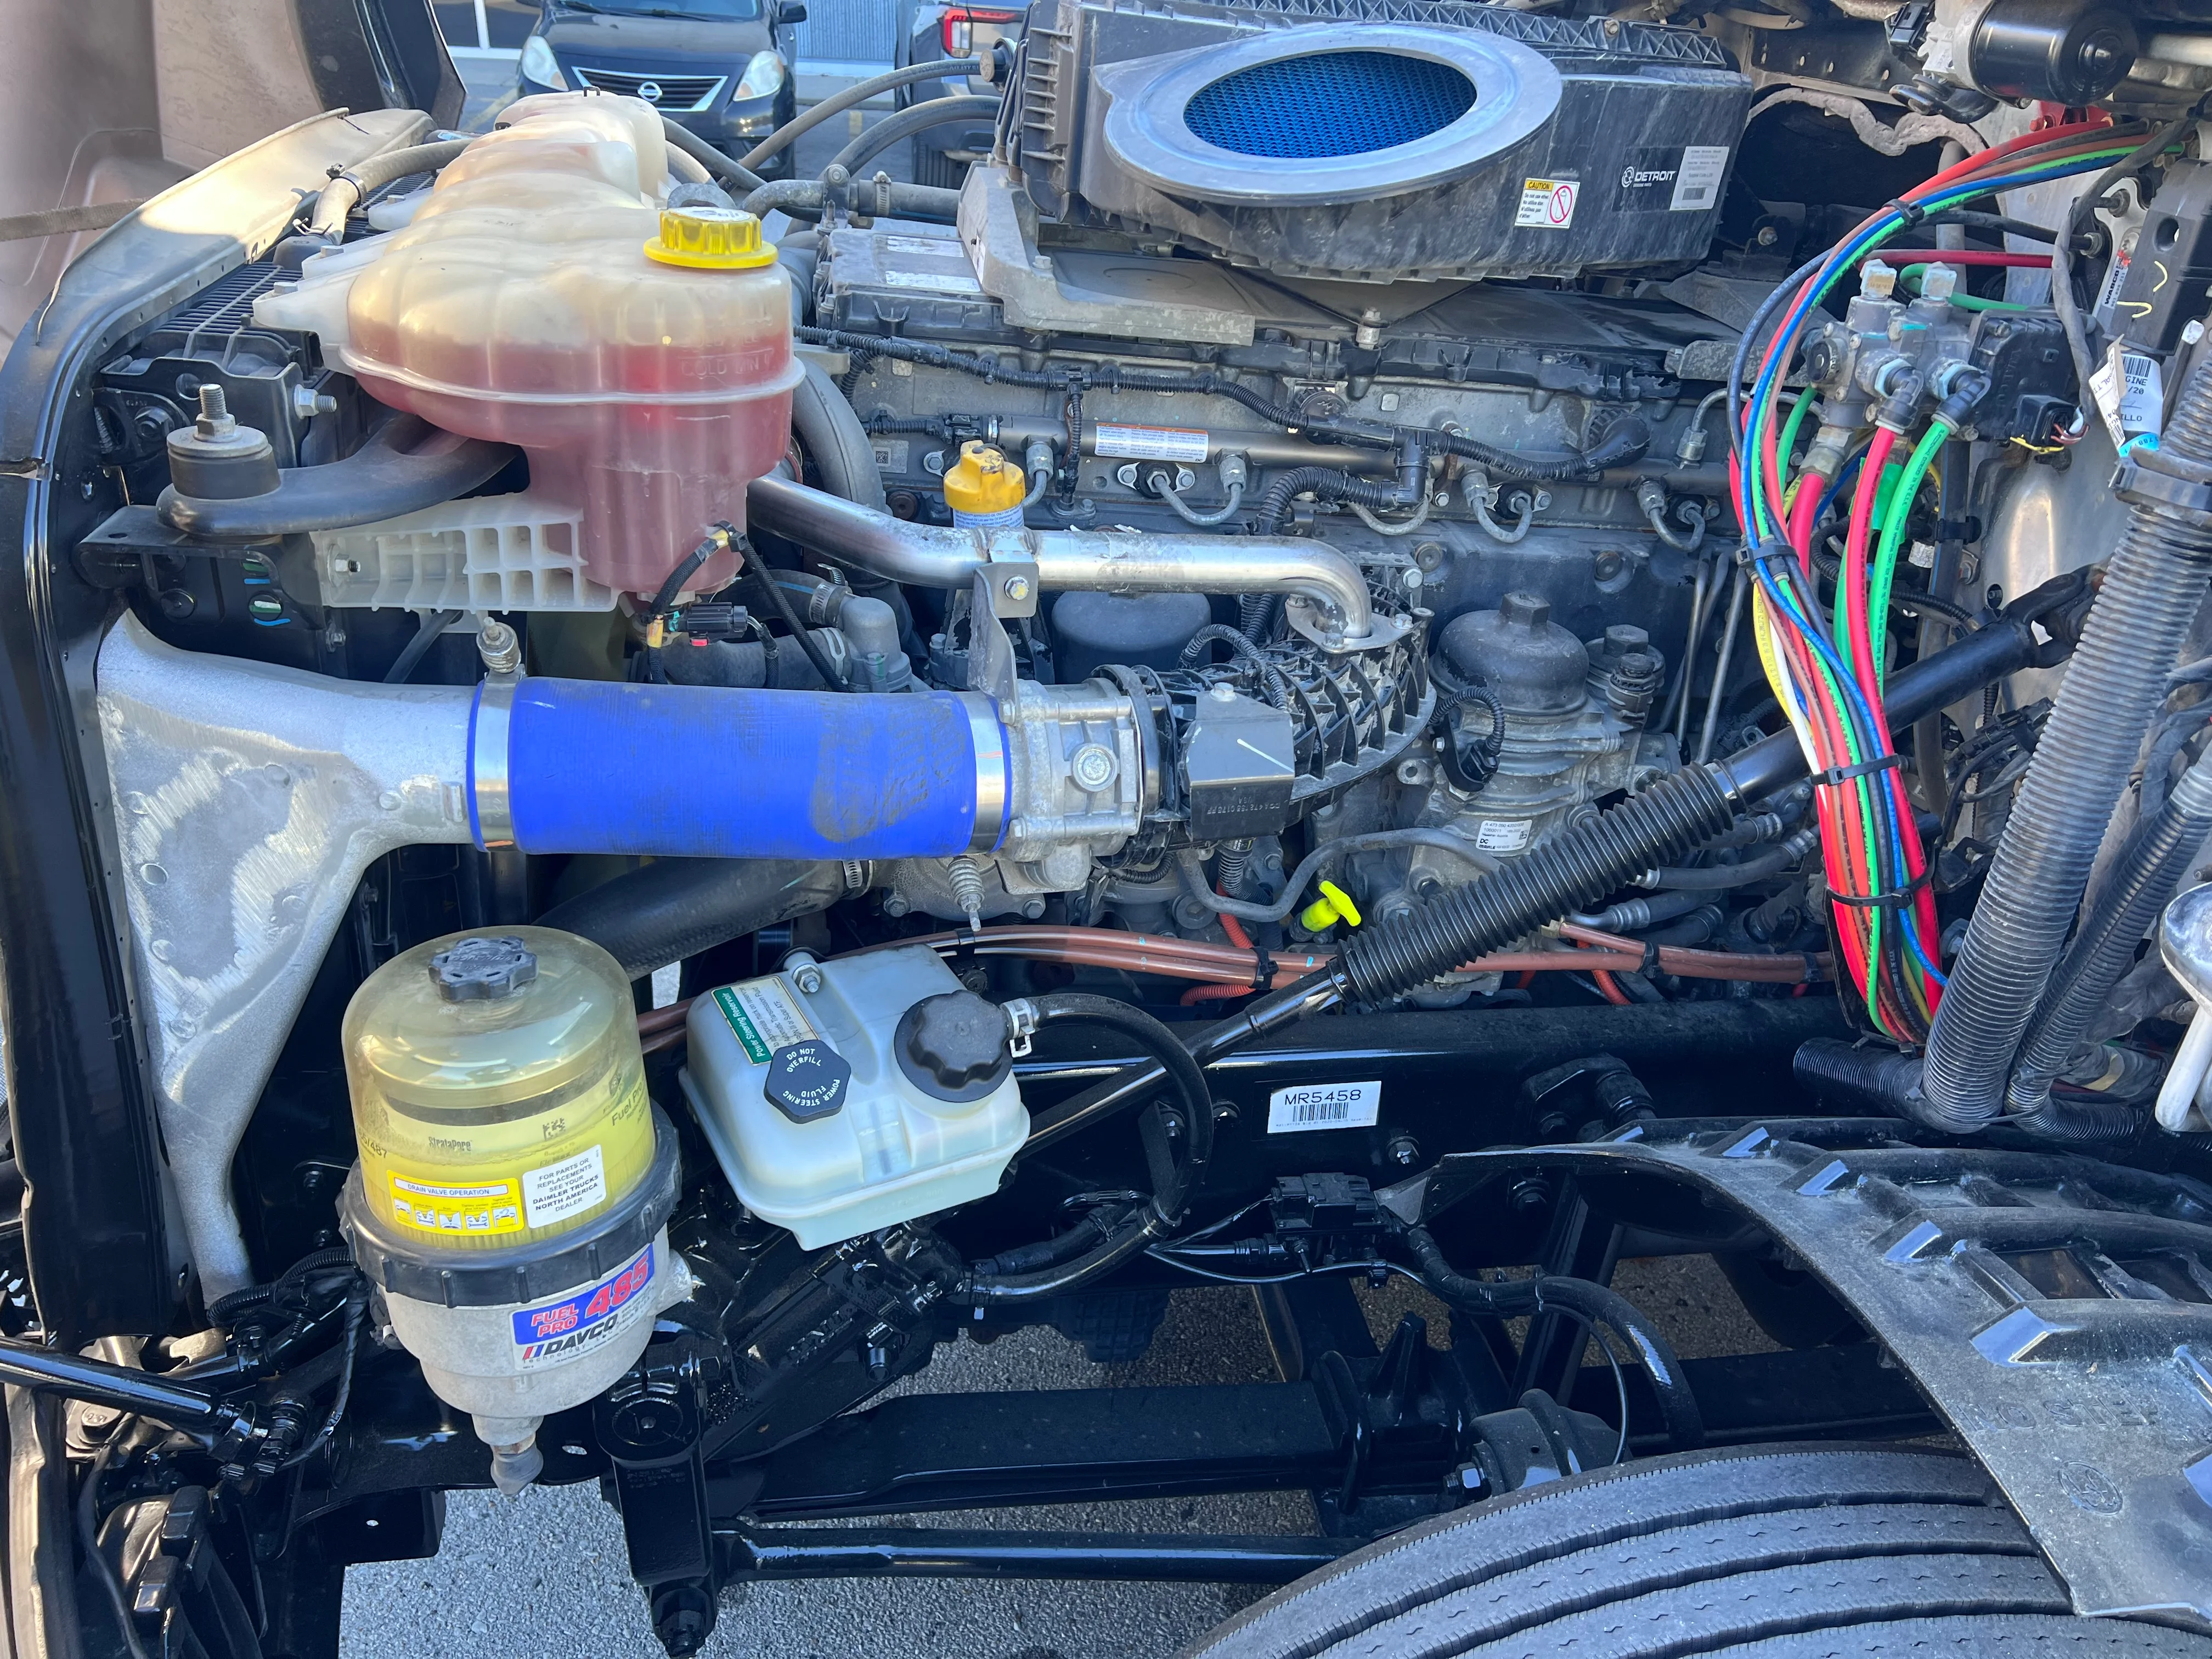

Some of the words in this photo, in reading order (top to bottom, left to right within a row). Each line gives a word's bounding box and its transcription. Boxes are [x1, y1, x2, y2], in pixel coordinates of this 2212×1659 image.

[1528, 182, 1550, 190] CAUTION
[1634, 171, 1677, 182] DETROIT
[2104, 270, 2119, 304] WABCO
[2125, 375, 2148, 386] GINE
[722, 992, 742, 1018] Reservoir
[737, 1017, 755, 1040] Steering
[752, 1040, 765, 1058] Power
[786, 1051, 797, 1060] DO
[786, 1056, 822, 1073] OVERFILL
[782, 1090, 821, 1107] STEERING
[800, 1085, 827, 1098] FLUID
[823, 1079, 840, 1102] POWER
[1285, 1090, 1361, 1105] MR5458
[611, 1102, 631, 1126] Fuel
[428, 1136, 471, 1152] StrataPore
[537, 1163, 592, 1189] REPLACEMENTS
[538, 1172, 555, 1181] FOR
[556, 1163, 578, 1178] PARTS
[579, 1158, 589, 1167] OR
[408, 1183, 426, 1193] DRAIN
[427, 1188, 448, 1196] VALVE
[449, 1188, 489, 1197] OPERATION
[533, 1189, 568, 1205] DAIMLER
[571, 1174, 599, 1192] TRUCKS
[549, 1183, 564, 1193] SEE
[565, 1175, 584, 1189] YOUR
[535, 1198, 563, 1211] NORTH
[565, 1182, 598, 1201] AMERICA
[555, 1197, 583, 1212] DEALER
[585, 1250, 649, 1319] 485
[531, 1303, 579, 1327] FUEL
[537, 1316, 578, 1338] PRO
[543, 1313, 618, 1356] DAVCO
[522, 1344, 586, 1363] Technology
[1957, 1402, 2037, 1432] NO
